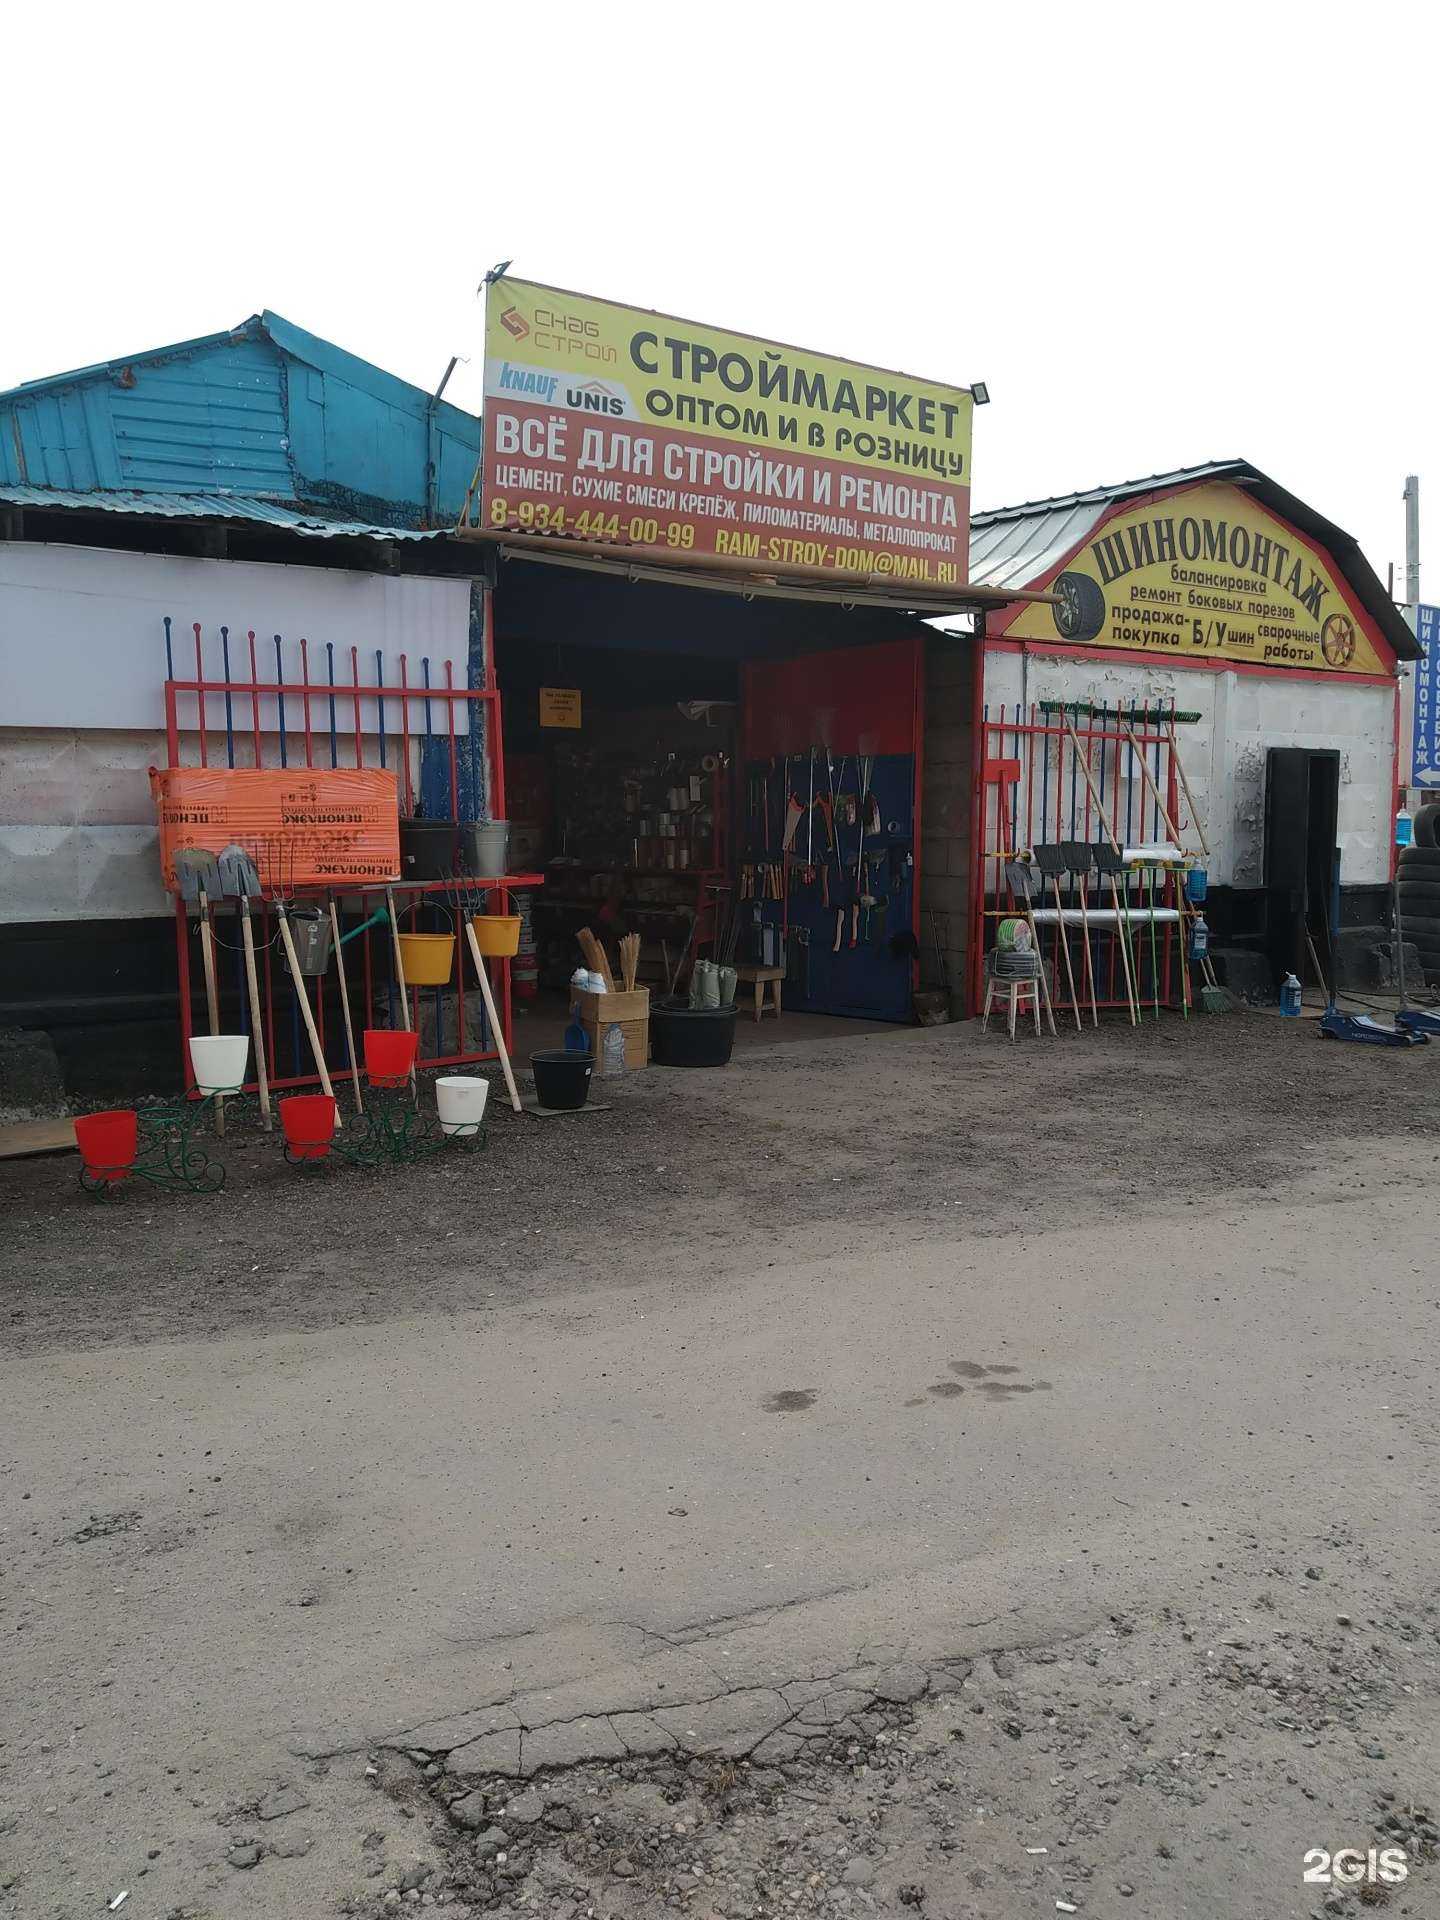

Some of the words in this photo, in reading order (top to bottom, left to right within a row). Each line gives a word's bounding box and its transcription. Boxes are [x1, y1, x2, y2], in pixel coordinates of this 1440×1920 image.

[534, 331, 617, 364] СТРОЙ
[499, 362, 559, 402] KNAUF
[629, 331, 959, 439] СТРОЙМАРКЕТ
[566, 389, 624, 416] UNIS
[645, 389, 769, 437] ОПТОМ
[778, 414, 798, 442] И
[808, 422, 826, 447] В
[836, 427, 963, 478] РОЗНИЦУ
[495, 414, 567, 462] ВСЁ
[577, 427, 653, 477] ДЛЯ
[664, 443, 804, 501] СТРОЙКИ
[812, 469, 831, 506] И
[840, 475, 957, 528] РЕМОНТА
[496, 464, 567, 496] ЦЕМЕНТ,
[573, 476, 621, 502] СУХИЕ
[626, 484, 675, 510] СМЕСИ
[679, 491, 740, 522] КРЕПЁЖ,
[743, 503, 860, 540] ПИЛОМАТЕРИАЛЫ,
[864, 522, 957, 553] МЕТАЛЛОПРОКАТ
[491, 498, 694, 548] 8-934-444-00-99
[715, 529, 957, 584] RAM-STROY-DOM@MAIL.RU
[1091, 517, 1331, 623] ШИНОМОНТАЖ
[1171, 563, 1266, 594] балансировка
[1130, 585, 1182, 603] ремонт
[1188, 590, 1243, 611] боковых
[1249, 601, 1295, 619] порезов
[1112, 625, 1180, 646] покупка
[1192, 619, 1227, 648] Б/У
[1228, 631, 1254, 644] шин
[1257, 623, 1320, 643] сварочные
[1264, 644, 1314, 660] работы
[1416, 608, 1433, 765] ШИНОМОНТАЖ
